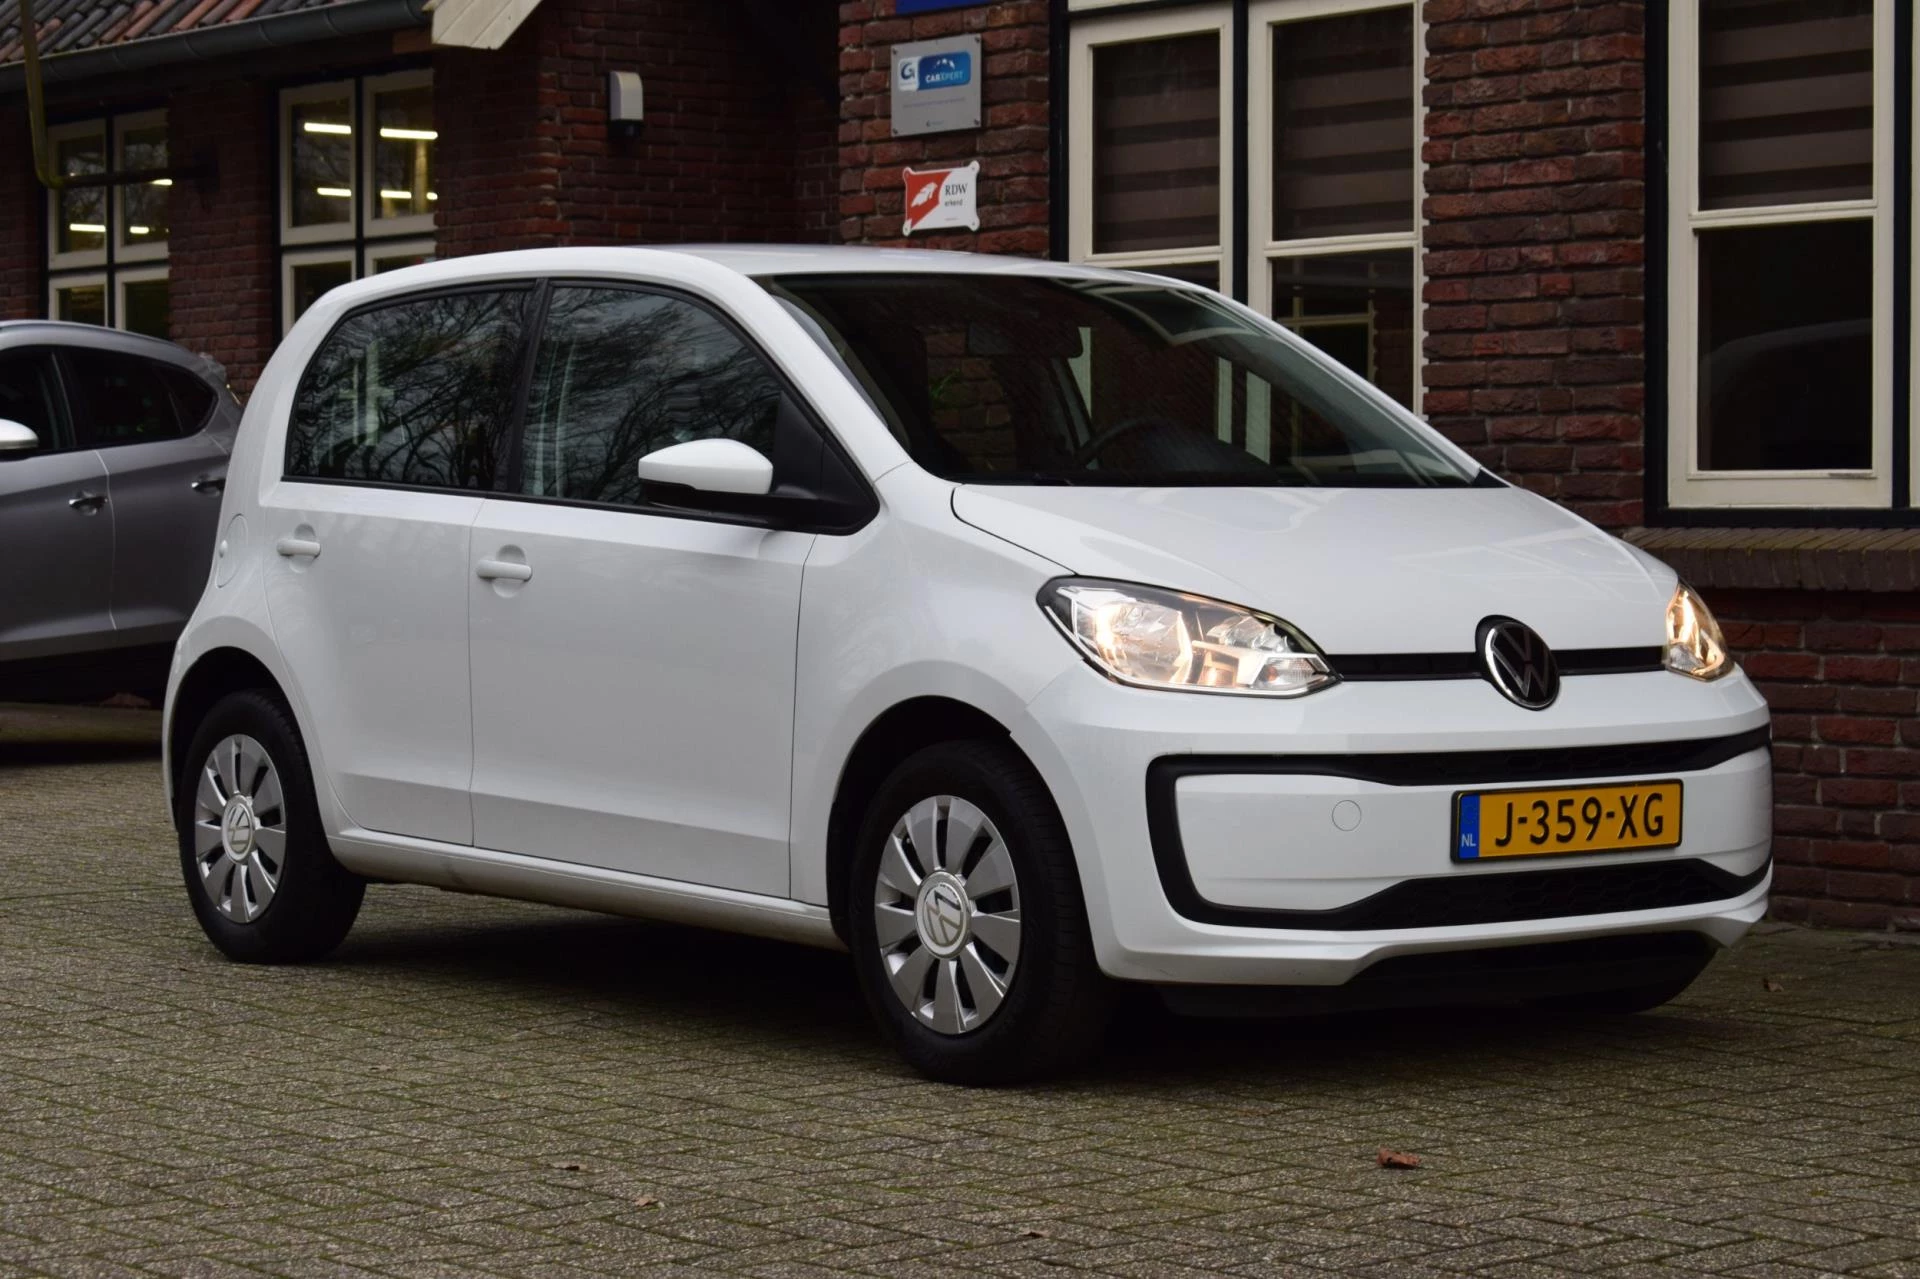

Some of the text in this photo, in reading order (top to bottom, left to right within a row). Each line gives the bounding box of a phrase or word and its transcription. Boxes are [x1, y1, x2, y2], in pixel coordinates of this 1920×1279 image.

[945, 183, 968, 196] RDW
[1495, 792, 1664, 848] J-359-XG
[1461, 833, 1476, 848] NL
